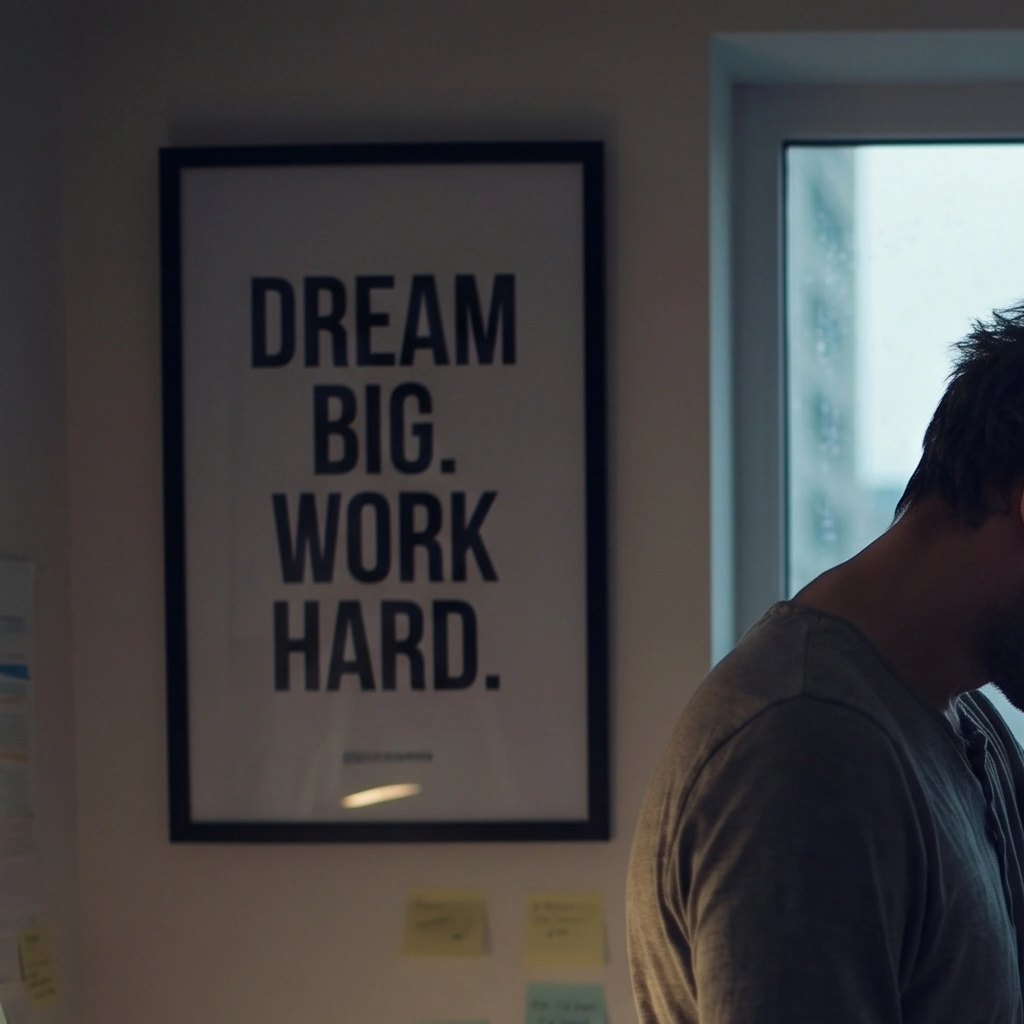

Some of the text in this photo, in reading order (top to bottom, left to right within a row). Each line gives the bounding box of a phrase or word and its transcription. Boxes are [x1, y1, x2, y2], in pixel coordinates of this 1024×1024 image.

[250, 273, 516, 369] DREAM
[312, 380, 457, 477] BIG.
[270, 490, 499, 585] WORK
[273, 598, 500, 692] HARD.
